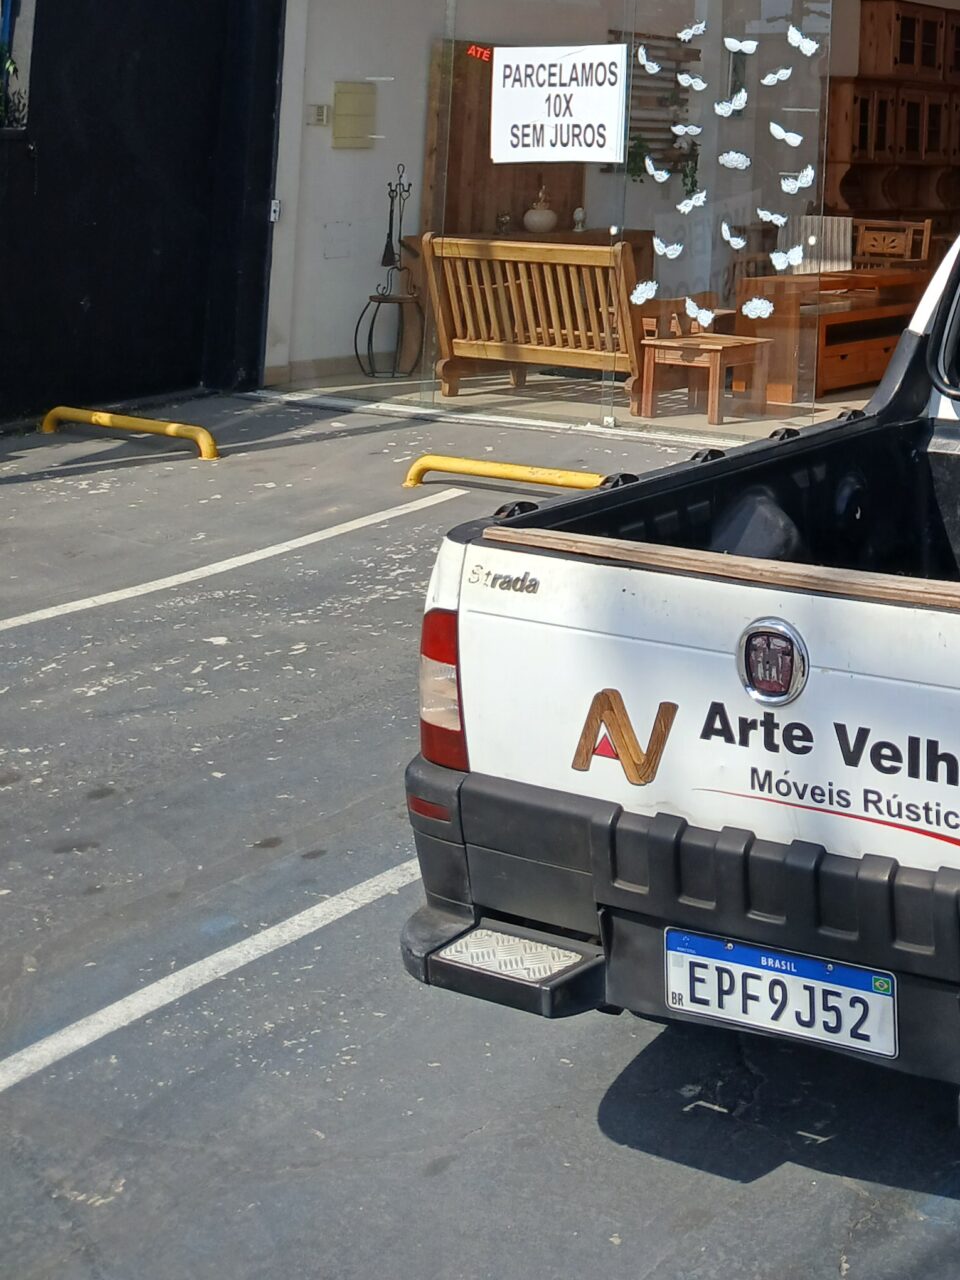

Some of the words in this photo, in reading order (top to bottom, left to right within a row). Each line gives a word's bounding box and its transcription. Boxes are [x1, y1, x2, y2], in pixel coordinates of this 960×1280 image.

[467, 44, 492, 62] ATÉ
[502, 61, 618, 88] PARCELAMOS
[544, 93, 574, 118] 10X
[510, 123, 545, 149] SEM
[550, 123, 607, 149] JUROS
[468, 564, 540, 594] Strada
[700, 701, 814, 755] Arte
[750, 767, 852, 809] Móveis
[760, 955, 797, 972] BRASIL
[671, 991, 684, 1007] BR
[688, 960, 871, 1042] EPF9J52
